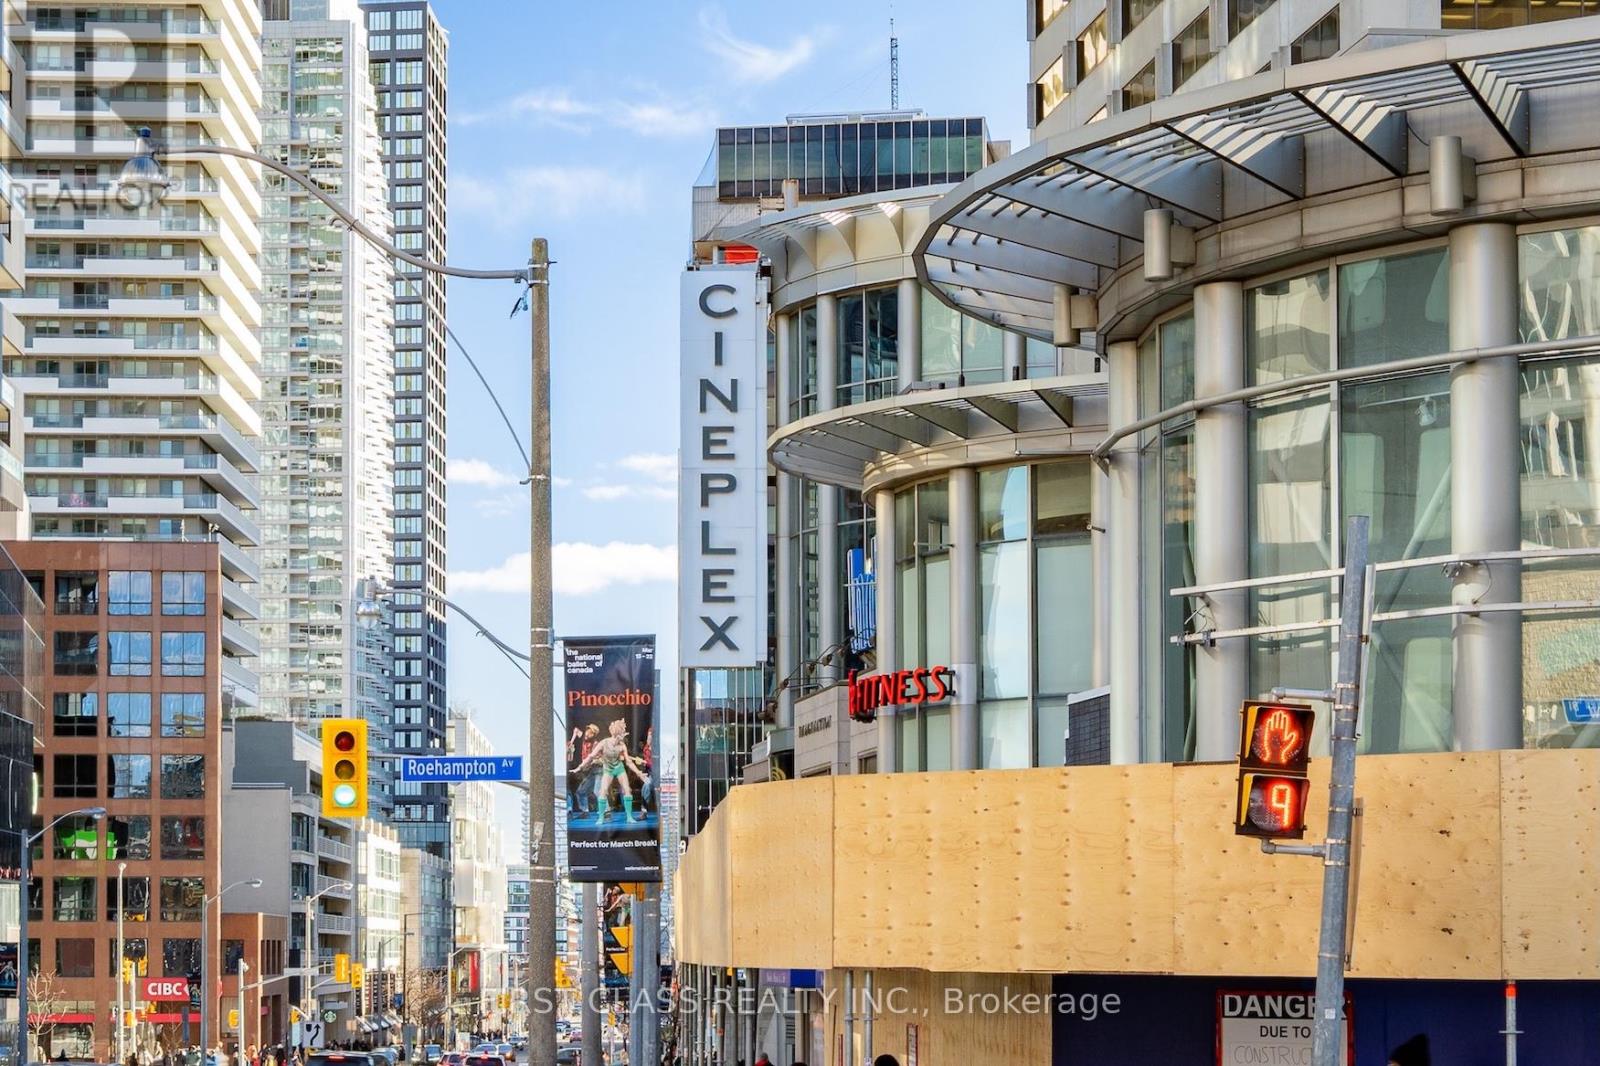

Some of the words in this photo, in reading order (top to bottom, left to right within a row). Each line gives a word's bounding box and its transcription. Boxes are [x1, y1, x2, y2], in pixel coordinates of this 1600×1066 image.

[698, 283, 740, 652] CINEPLEX
[566, 648, 578, 656] the
[575, 653, 603, 661] national
[567, 688, 651, 707] Pinocchio
[408, 760, 496, 779] Roehampton
[502, 759, 514, 768] Av
[1271, 784, 1290, 827] 9
[570, 841, 597, 849] Perfect
[610, 840, 634, 848] March
[147, 982, 183, 996] CIBC
[1223, 994, 1346, 1018] DANGE
[1260, 1025, 1288, 1038] DUE
[1292, 1025, 1312, 1039] TO
[1234, 1045, 1313, 1066] CONSTRUC
